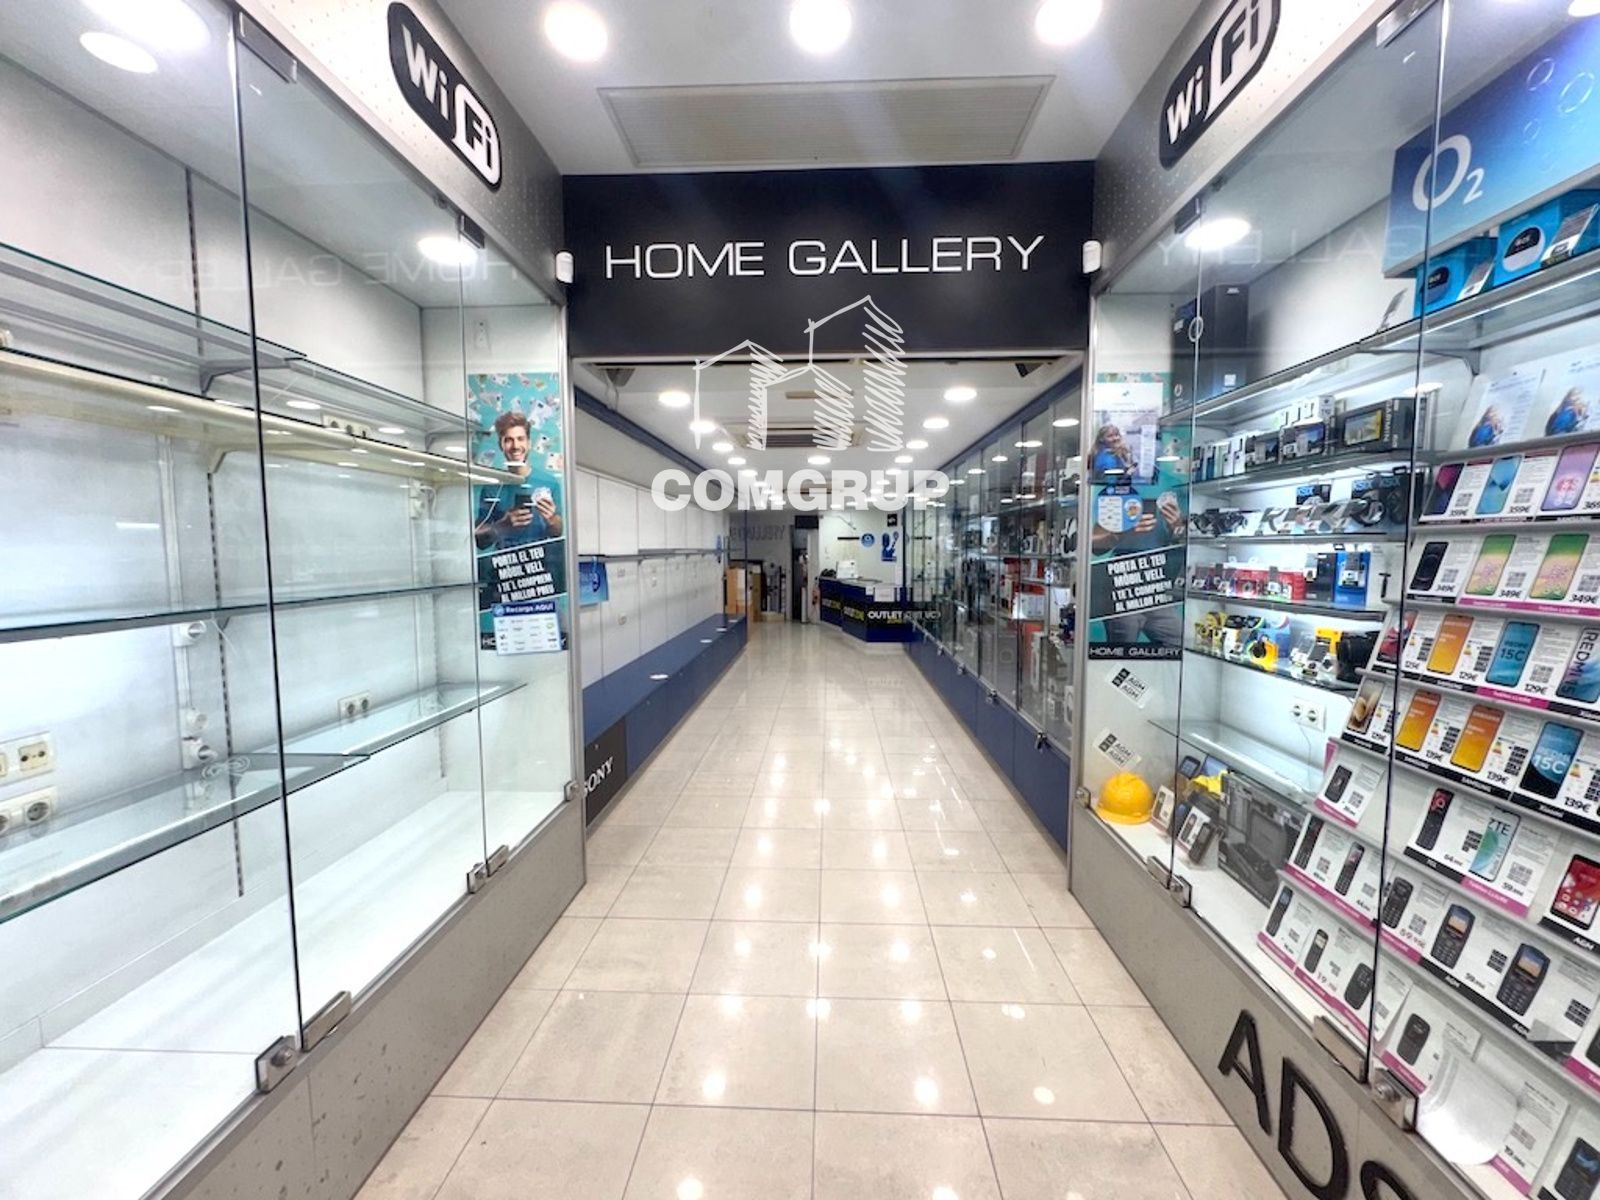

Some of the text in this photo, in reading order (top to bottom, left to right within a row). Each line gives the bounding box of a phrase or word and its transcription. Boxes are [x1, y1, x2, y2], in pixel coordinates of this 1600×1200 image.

[605, 235, 1045, 279] HOME GALLERY
[492, 546, 545, 569] PORTA EL TEU
[1107, 553, 1167, 576] PORTA EL TEU
[525, 560, 544, 574] VELL
[1144, 567, 1166, 582] VELL
[1089, 647, 1181, 656] HOME GALLERY
[1564, 796, 1592, 814] 139€
[1488, 818, 1512, 837] ZTE
